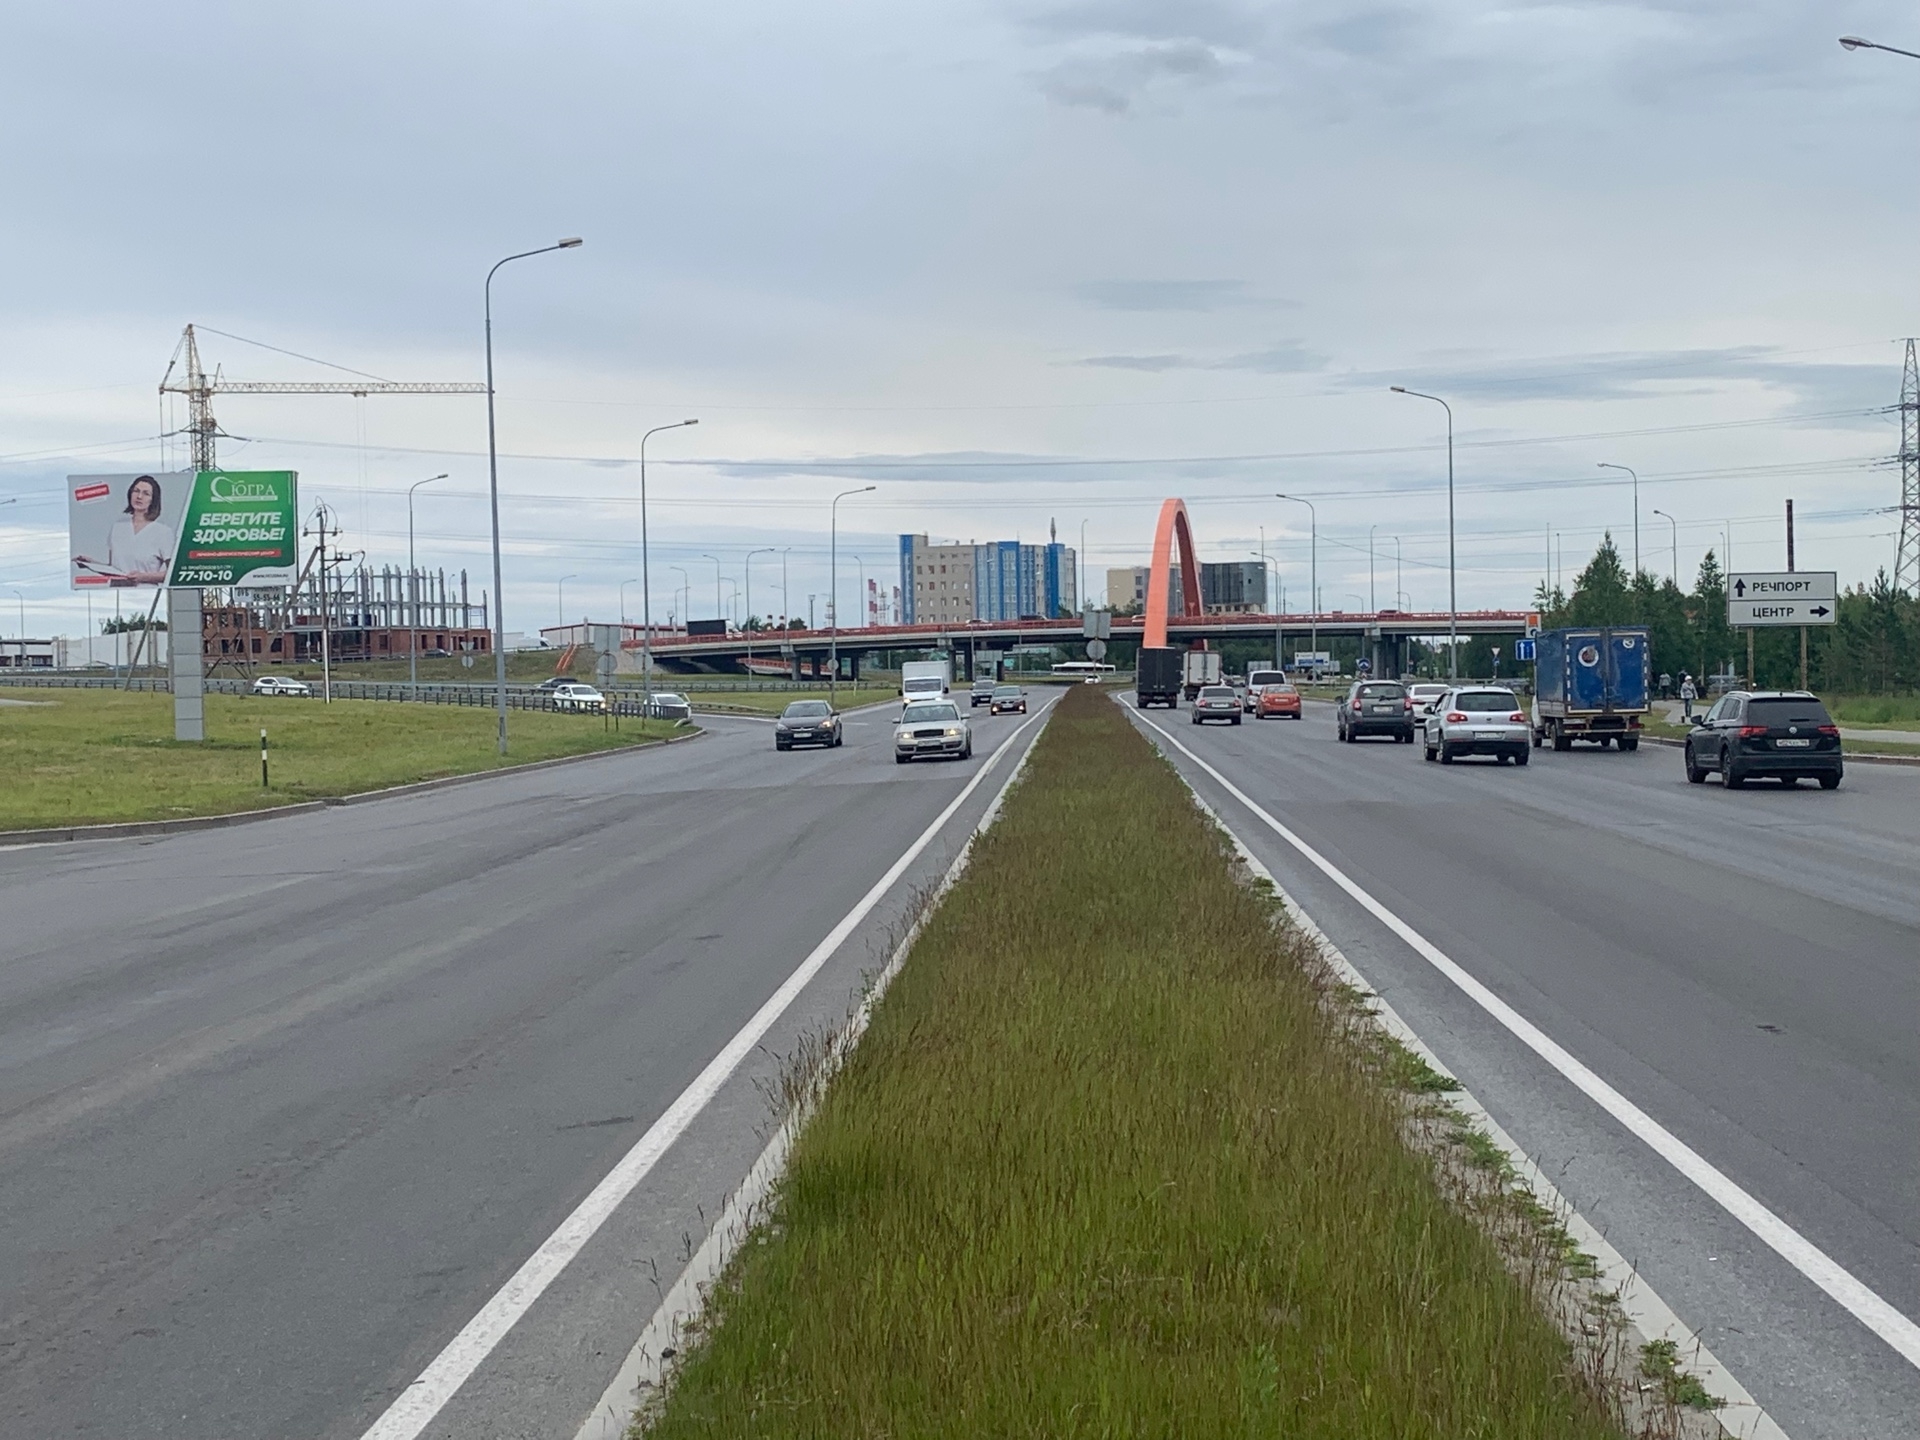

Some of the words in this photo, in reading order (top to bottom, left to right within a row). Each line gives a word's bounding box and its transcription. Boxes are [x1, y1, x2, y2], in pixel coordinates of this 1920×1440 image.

[199, 512, 282, 526] БЕРЕГИТЕ
[193, 528, 286, 544] ЗДОРОВЬЕ!
[178, 570, 233, 582] 77-10-10
[1752, 581, 1811, 592] РЕЧПОРТ
[1752, 607, 1795, 619] ЦЕНТР
